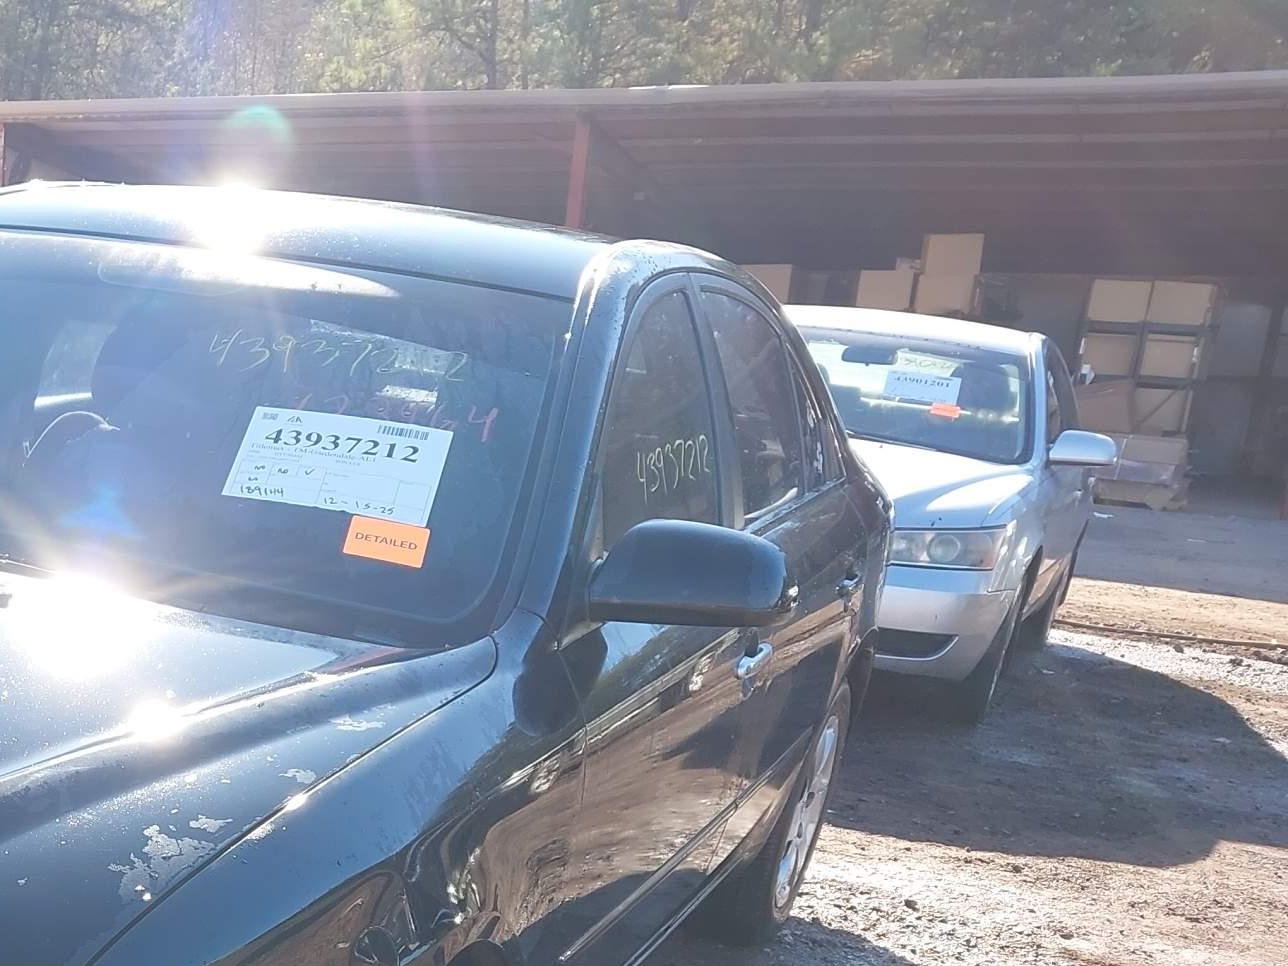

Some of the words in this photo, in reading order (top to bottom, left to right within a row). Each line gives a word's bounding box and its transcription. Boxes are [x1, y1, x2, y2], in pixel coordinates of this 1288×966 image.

[264, 428, 420, 463] 43937212
[637, 434, 711, 505] 43937212
[355, 532, 418, 551] DETAILED
